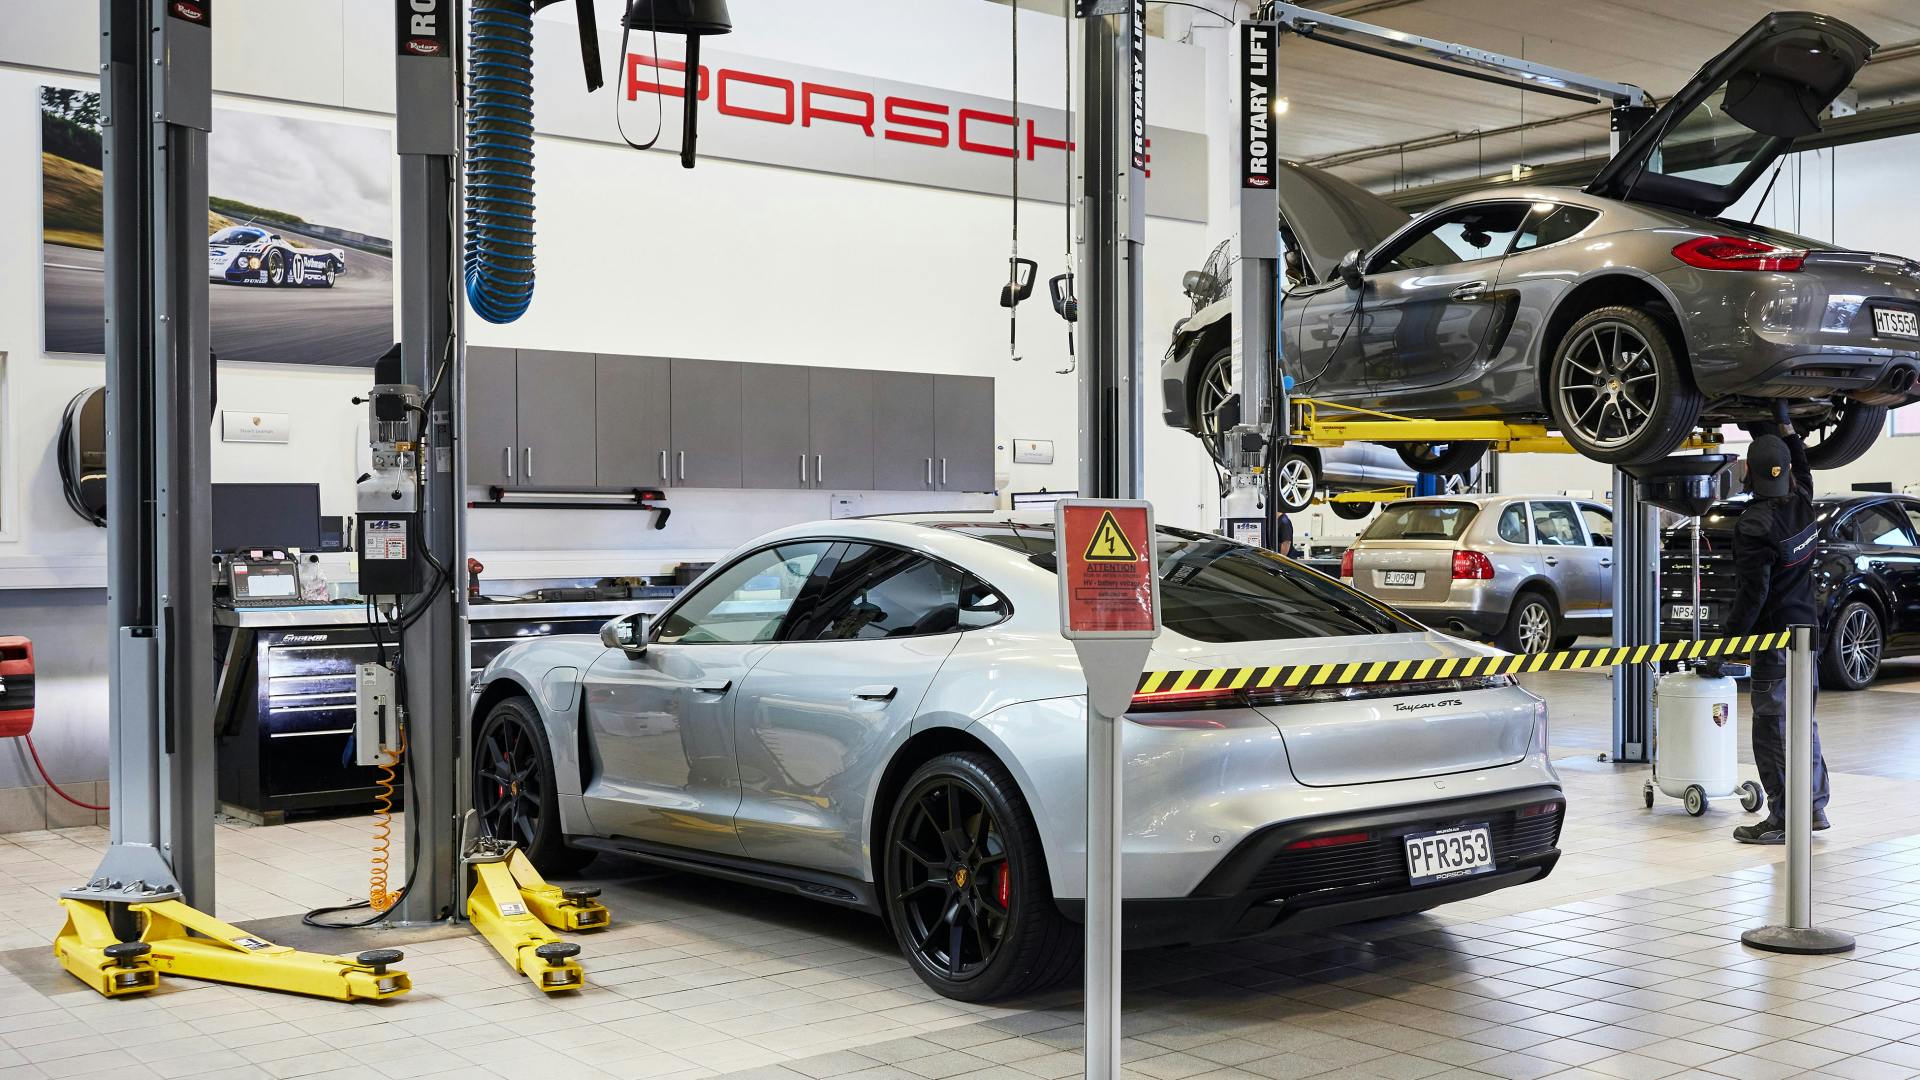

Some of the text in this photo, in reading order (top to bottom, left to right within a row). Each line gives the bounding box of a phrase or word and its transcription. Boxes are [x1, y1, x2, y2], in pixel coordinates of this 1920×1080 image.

[409, 41, 438, 52] Rotary
[627, 53, 1151, 178] PORSCH
[1134, 55, 1143, 154] ROTARY
[1250, 27, 1268, 174] ROTARY LIFT
[1087, 563, 1136, 572] ATTENTION
[1393, 699, 1463, 713] Taycan GTS
[1408, 832, 1489, 874] PFR353
